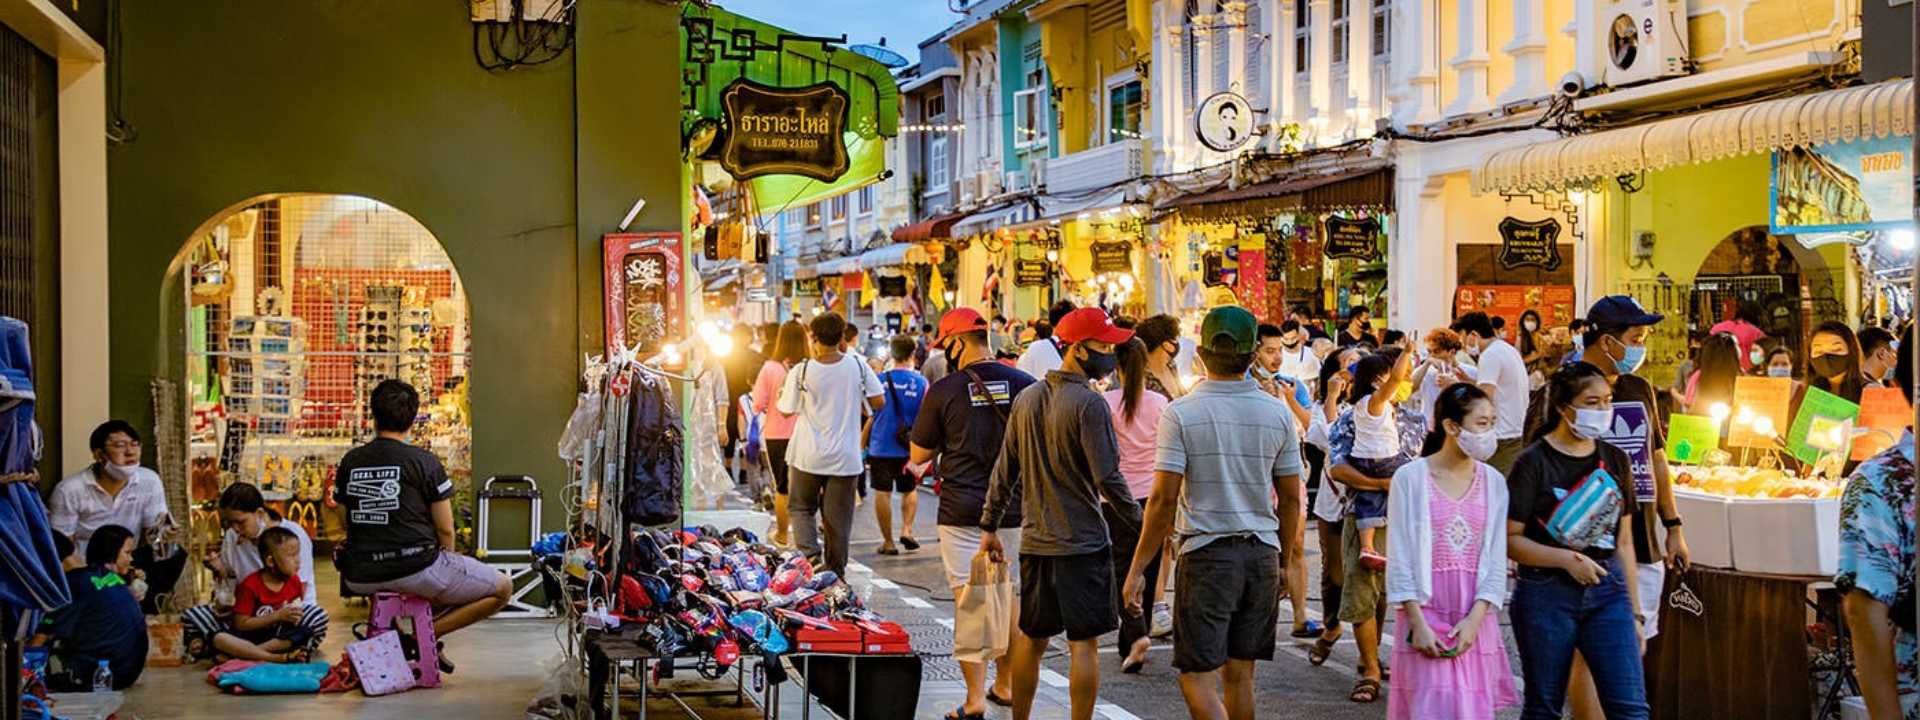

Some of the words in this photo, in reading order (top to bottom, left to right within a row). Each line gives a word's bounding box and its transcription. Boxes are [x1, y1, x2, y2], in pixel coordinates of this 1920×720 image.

[741, 106, 829, 134] ธาราอะไหล่
[376, 470, 395, 479] LIFE
